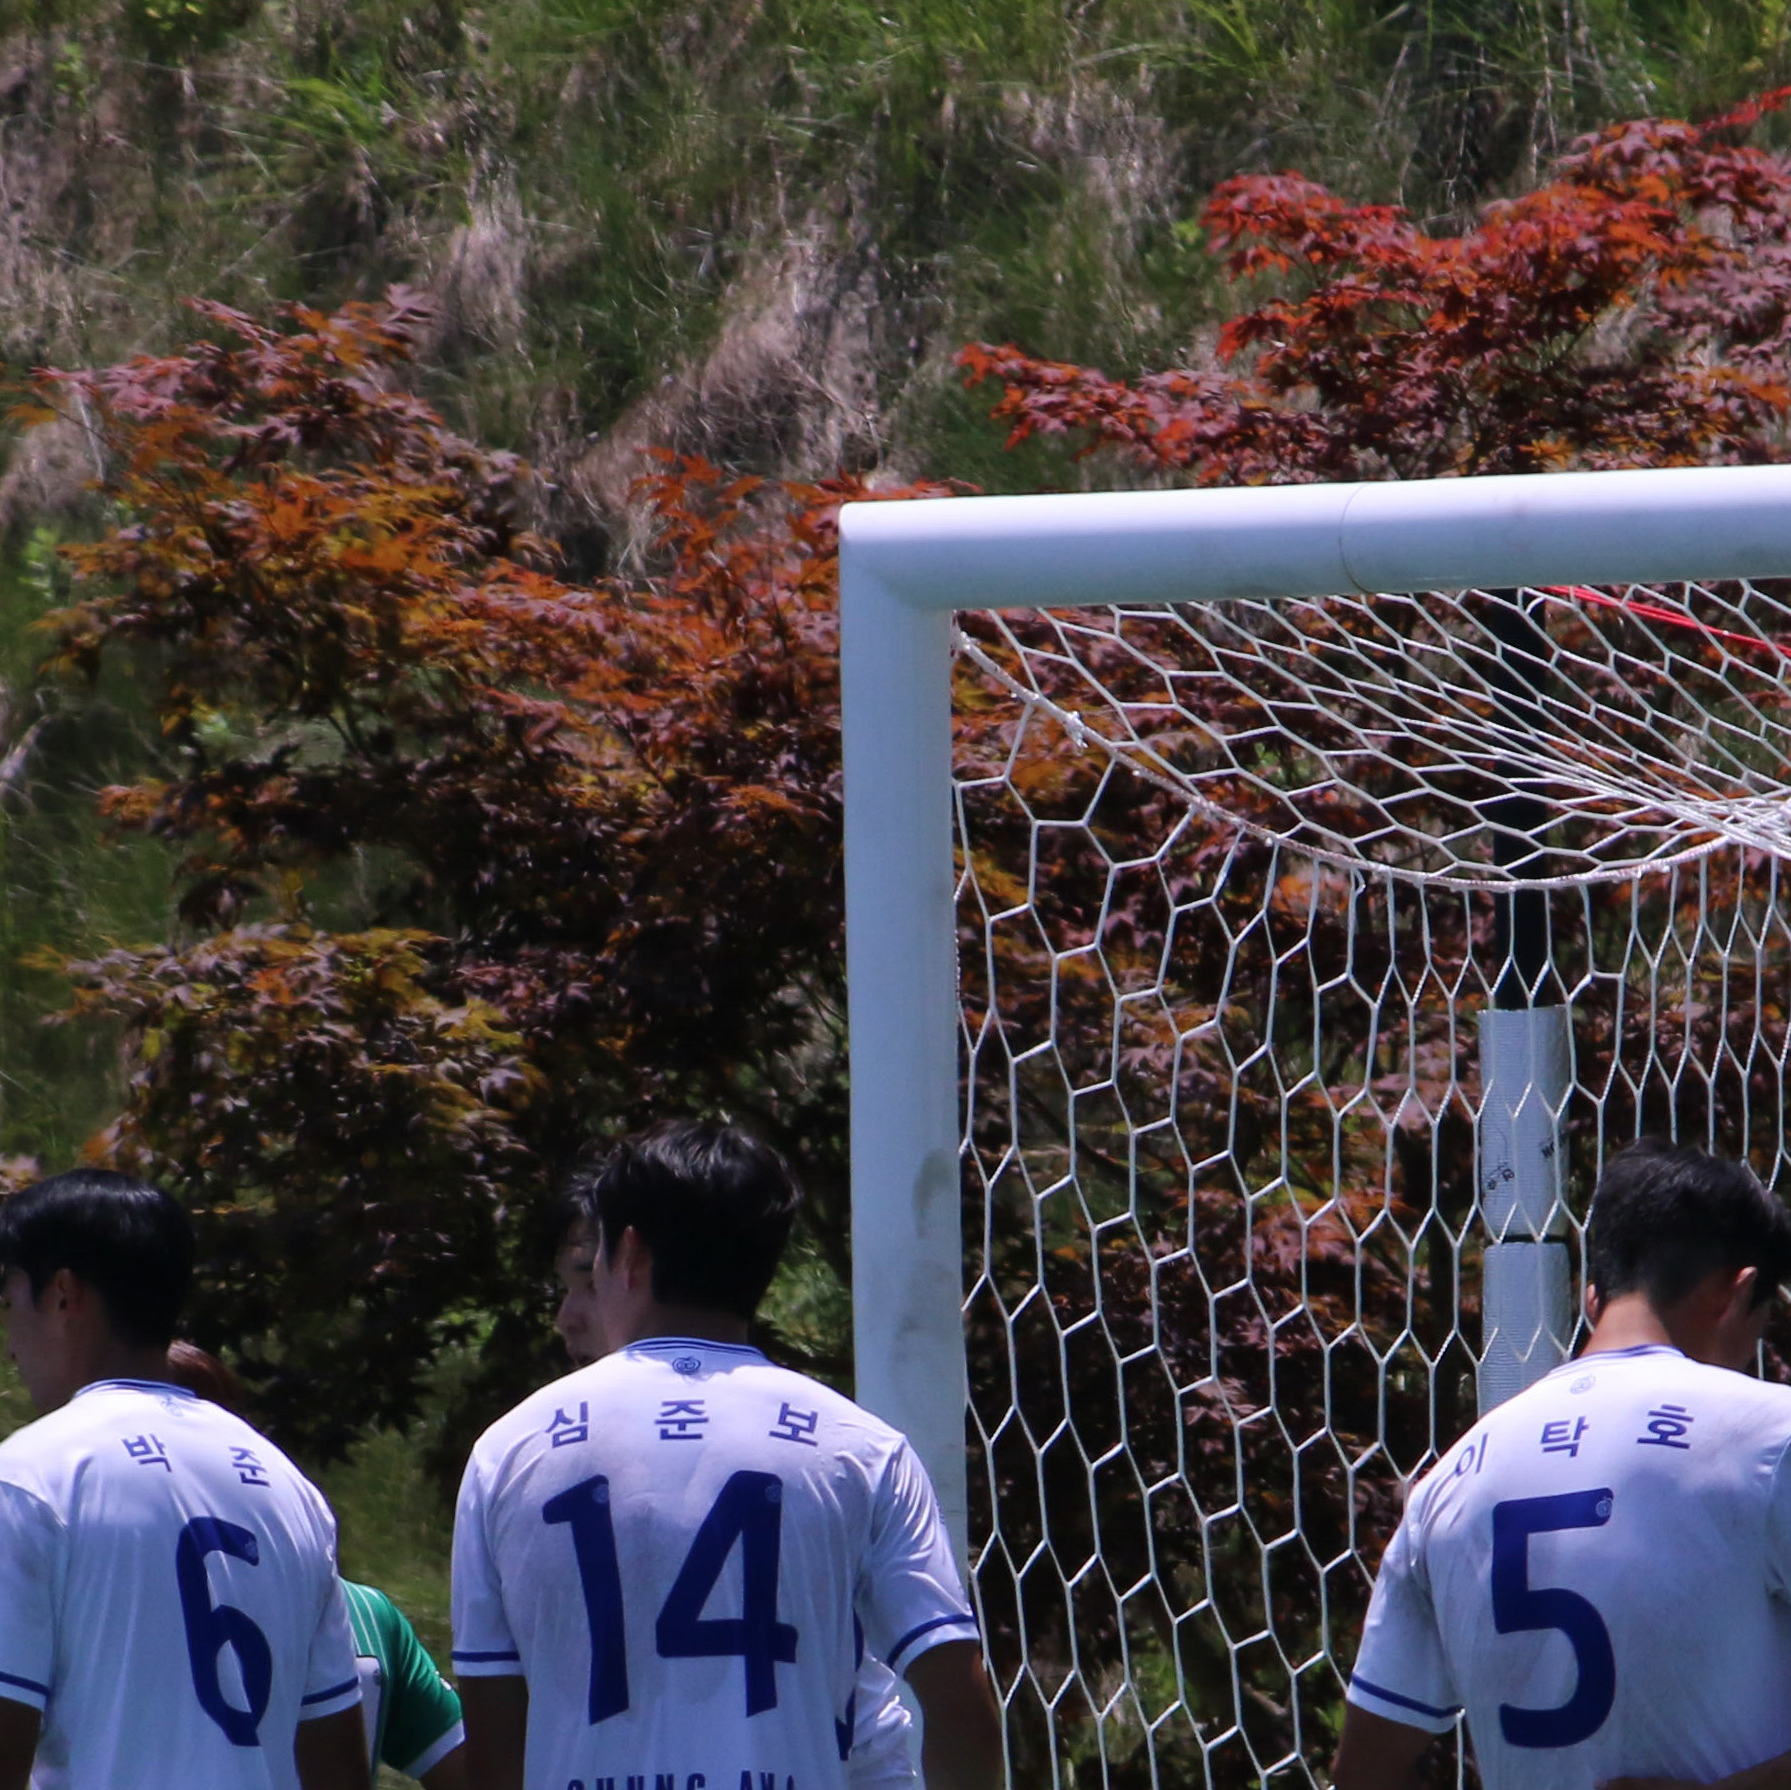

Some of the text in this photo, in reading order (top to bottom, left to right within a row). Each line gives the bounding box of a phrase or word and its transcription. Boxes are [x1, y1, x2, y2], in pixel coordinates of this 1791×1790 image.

[175, 1516, 272, 1747] 6
[541, 1469, 799, 1726] 14
[1490, 1486, 1616, 1748] 5
